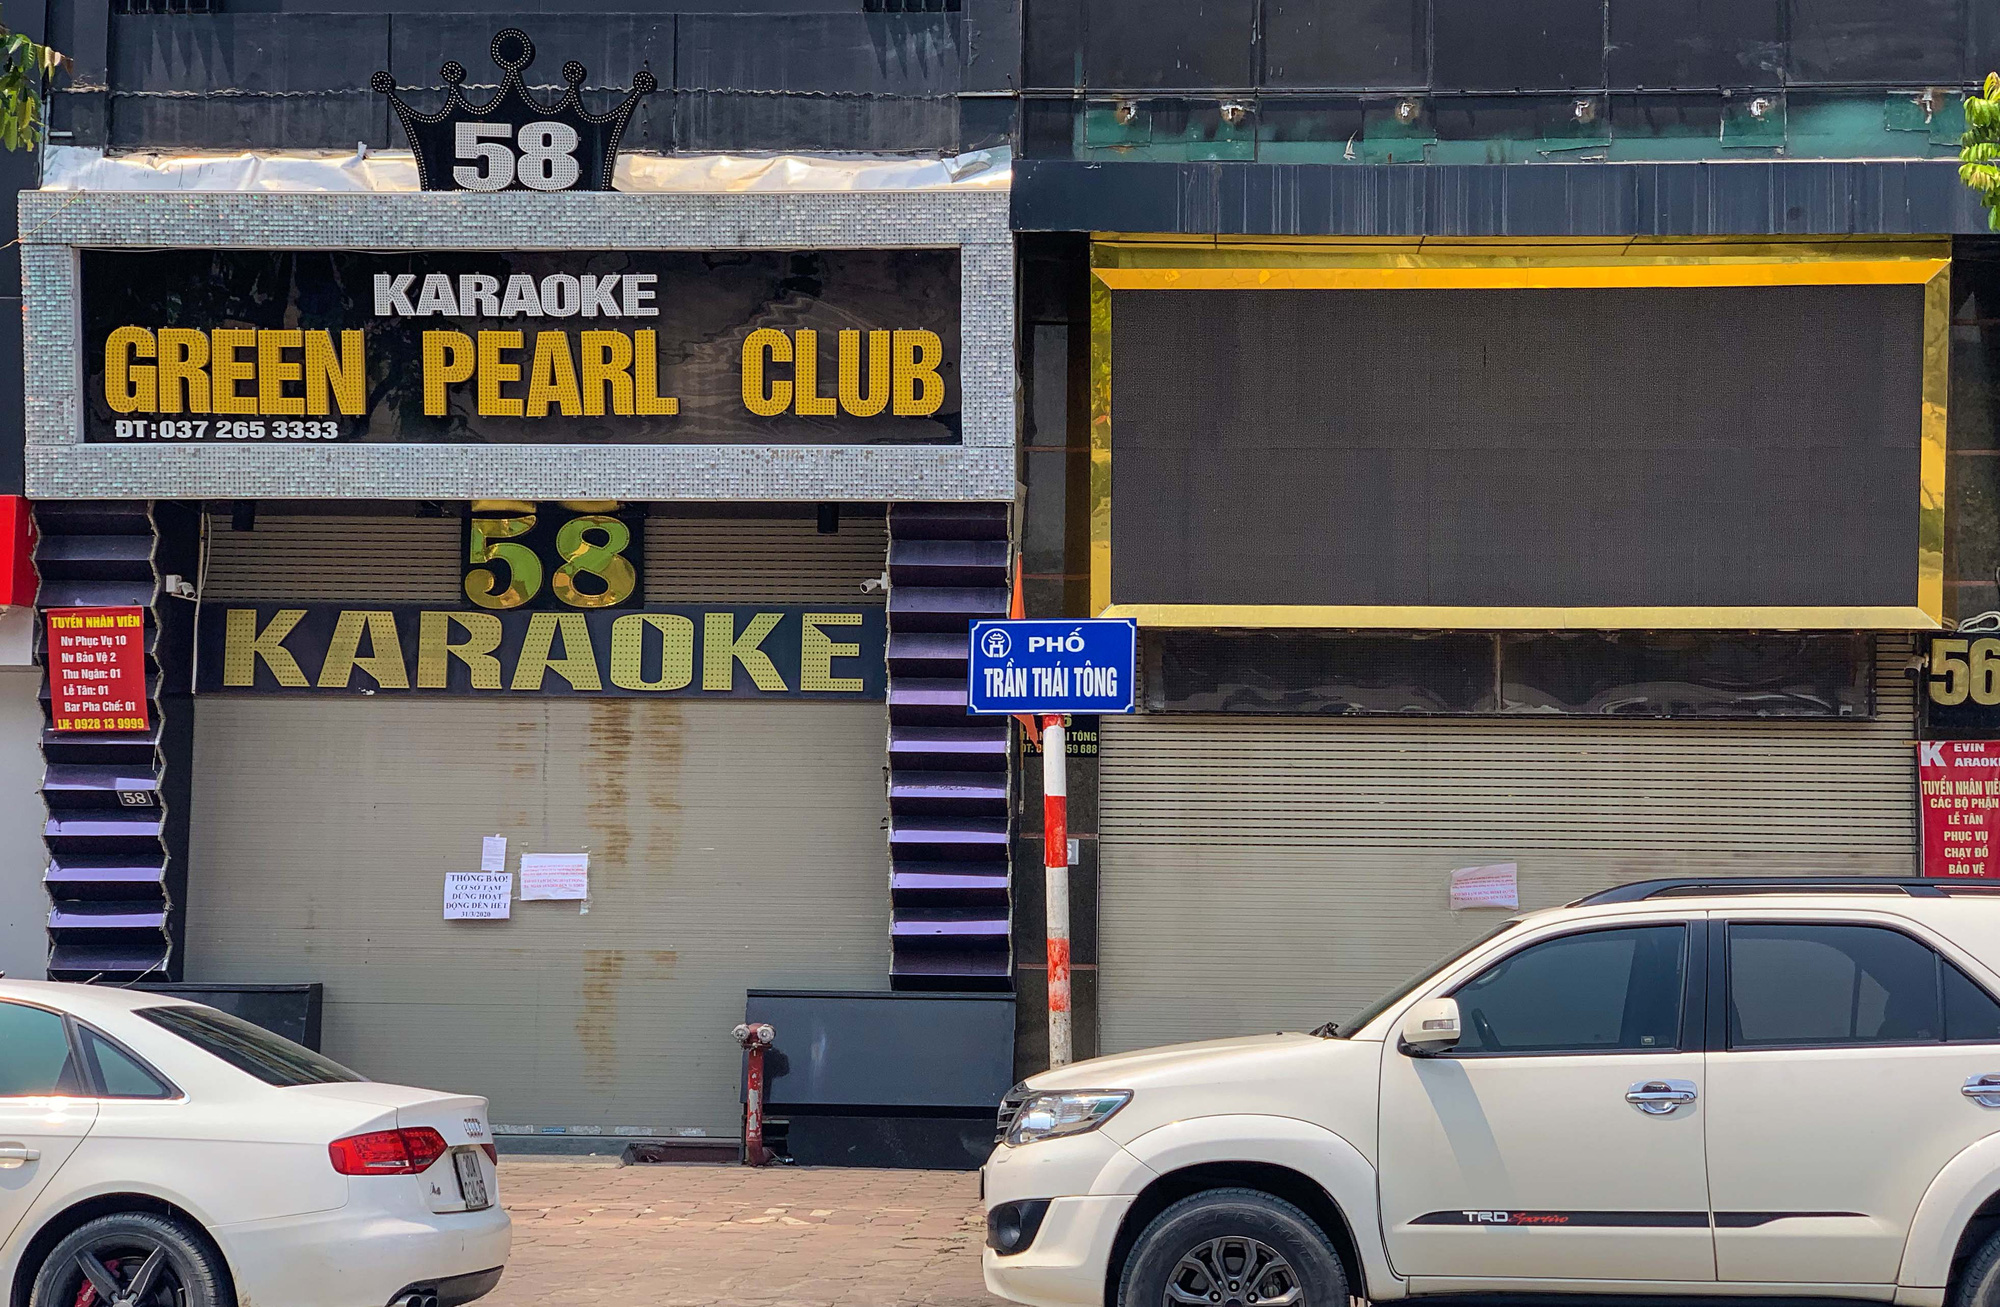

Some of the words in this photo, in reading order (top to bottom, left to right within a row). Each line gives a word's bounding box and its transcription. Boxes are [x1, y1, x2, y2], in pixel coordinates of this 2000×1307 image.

[453, 121, 581, 191] 58
[374, 273, 660, 316] KARAOKE
[105, 326, 367, 415] GREEN
[423, 329, 680, 417] PEARL
[741, 327, 947, 418] CLUB
[215, 421, 266, 439] 265
[272, 420, 339, 439] 3333
[464, 514, 637, 609] 58
[51, 613, 83, 629] TUYỂN
[85, 614, 114, 628] NHÂN
[116, 613, 141, 628] VIÊN
[60, 636, 74, 646] Nv
[75, 636, 99, 649] Phục
[100, 635, 113, 648] Vụ
[115, 635, 127, 646] 10
[1028, 627, 1085, 653] PHỐ
[223, 608, 864, 693] KARAOKE
[61, 652, 74, 663] Nv
[76, 651, 94, 663] Bảo
[96, 652, 108, 665] Vệ
[110, 652, 117, 662] 2
[62, 669, 80, 680] Thu
[81, 668, 109, 681] Ngân:
[110, 668, 121, 679] 01
[984, 658, 1027, 697] TRẦN
[1032, 661, 1068, 697] THÁI
[1074, 660, 1118, 697] TÔNG
[1930, 637, 2000, 706] 56
[76, 685, 97, 696] Tân:
[98, 685, 109, 695] 01
[64, 702, 81, 713] Bar
[82, 702, 101, 712] Pha
[102, 700, 124, 712] Chế:
[125, 701, 136, 712] 01
[57, 719, 72, 730] LH:
[74, 718, 101, 730] 0928
[103, 718, 115, 729] 13
[117, 718, 145, 729] 9999
[1072, 729, 1097, 742] TÔNG
[1080, 744, 1098, 754] 688
[1920, 741, 1947, 767] K
[1954, 743, 1985, 753] EVIN
[1922, 774, 1953, 795] TUYỂN
[1955, 777, 1983, 795] NHÂN
[1984, 777, 2000, 795] VIÊ
[123, 792, 148, 805] 58
[1930, 796, 1952, 809] CÁC
[1954, 796, 1969, 811] BỘ
[1971, 796, 1999, 811] PHẬN
[1962, 813, 1984, 825] TÂN
[1943, 831, 1972, 844] PHỤC
[1974, 831, 1989, 844] VỤ
[1944, 847, 1972, 860] CHẠY
[1948, 861, 1970, 875] BẢO
[1462, 1211, 1508, 1223] TRD
